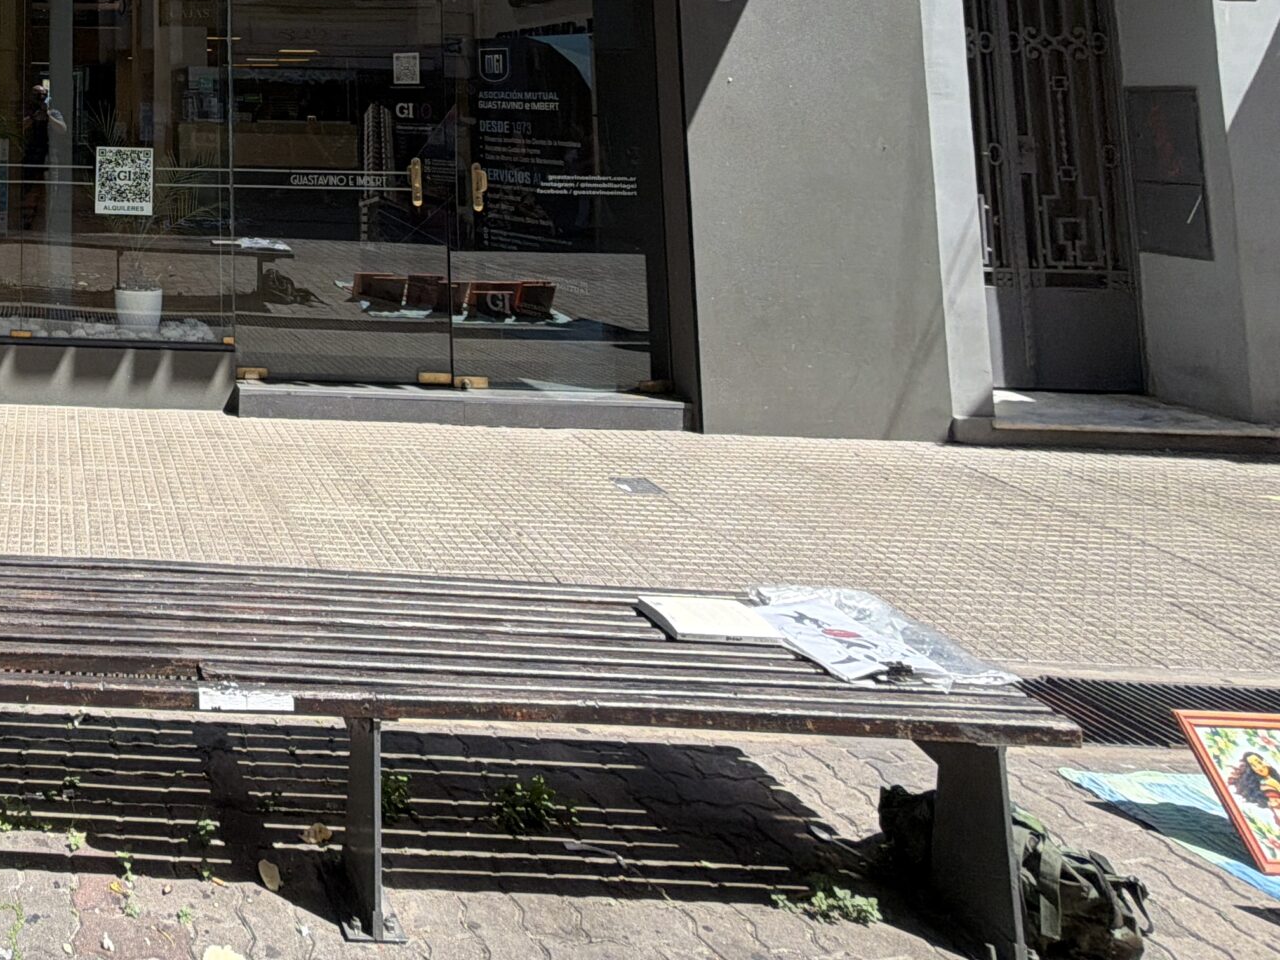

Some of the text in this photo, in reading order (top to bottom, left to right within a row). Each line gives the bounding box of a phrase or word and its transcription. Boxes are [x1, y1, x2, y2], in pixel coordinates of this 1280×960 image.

[479, 90, 559, 101] ASOCIACIÓN MUTUAL
[479, 100, 524, 110] GUASTAVINO
[531, 101, 560, 111] IMBERT
[480, 119, 511, 134] DESDE
[290, 174, 347, 187] GUASTAVINO
[356, 175, 387, 188] IMBERT
[483, 167, 532, 185] ERVICIOS
[103, 204, 145, 212] ALQUILERES
